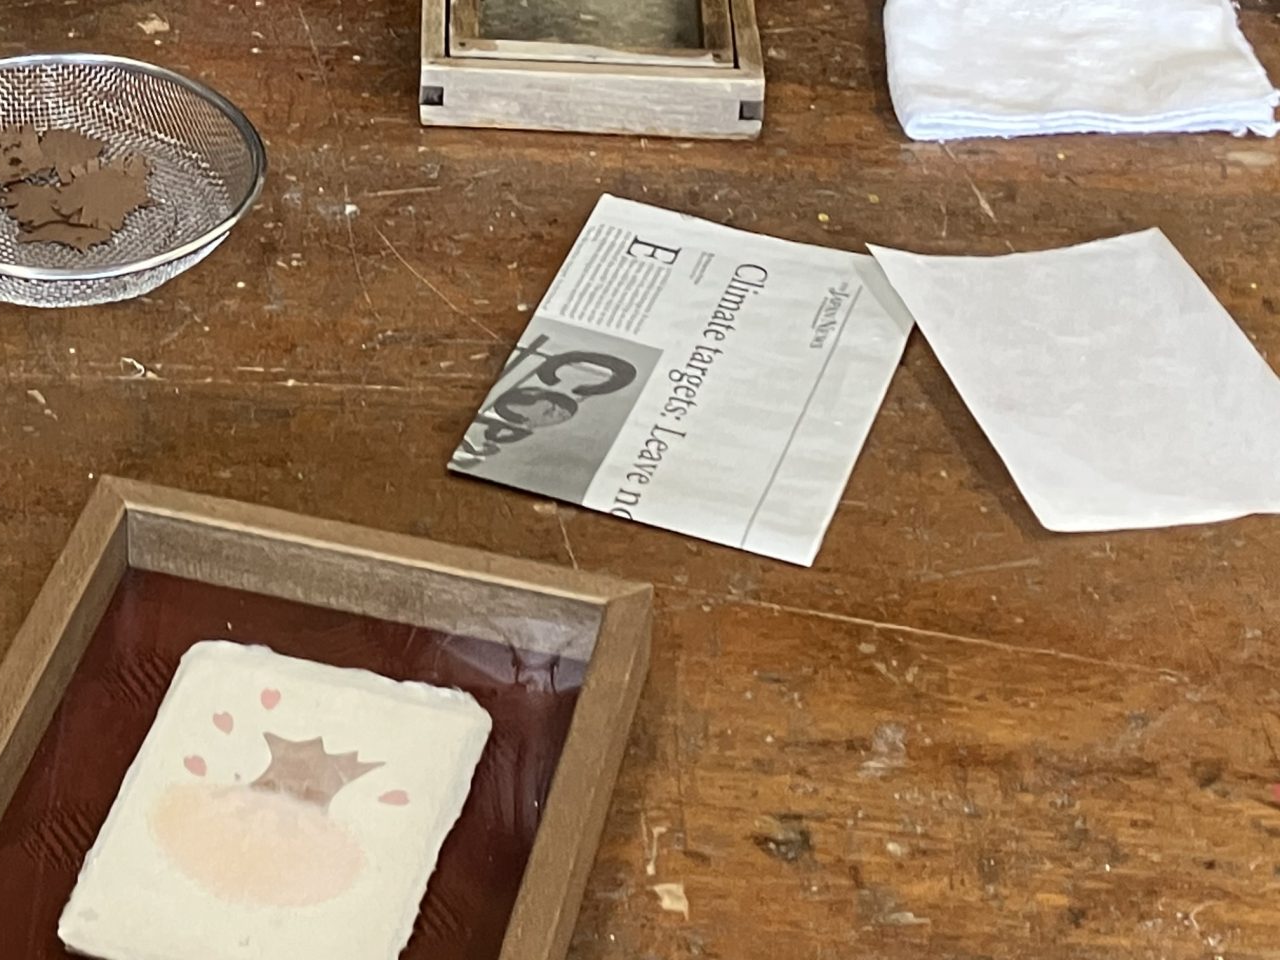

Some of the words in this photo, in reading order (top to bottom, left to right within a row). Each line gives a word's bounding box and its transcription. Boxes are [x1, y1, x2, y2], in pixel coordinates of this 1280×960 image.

[703, 263, 768, 342] Climate
[660, 345, 724, 421] targets:
[626, 423, 687, 485] Leave
